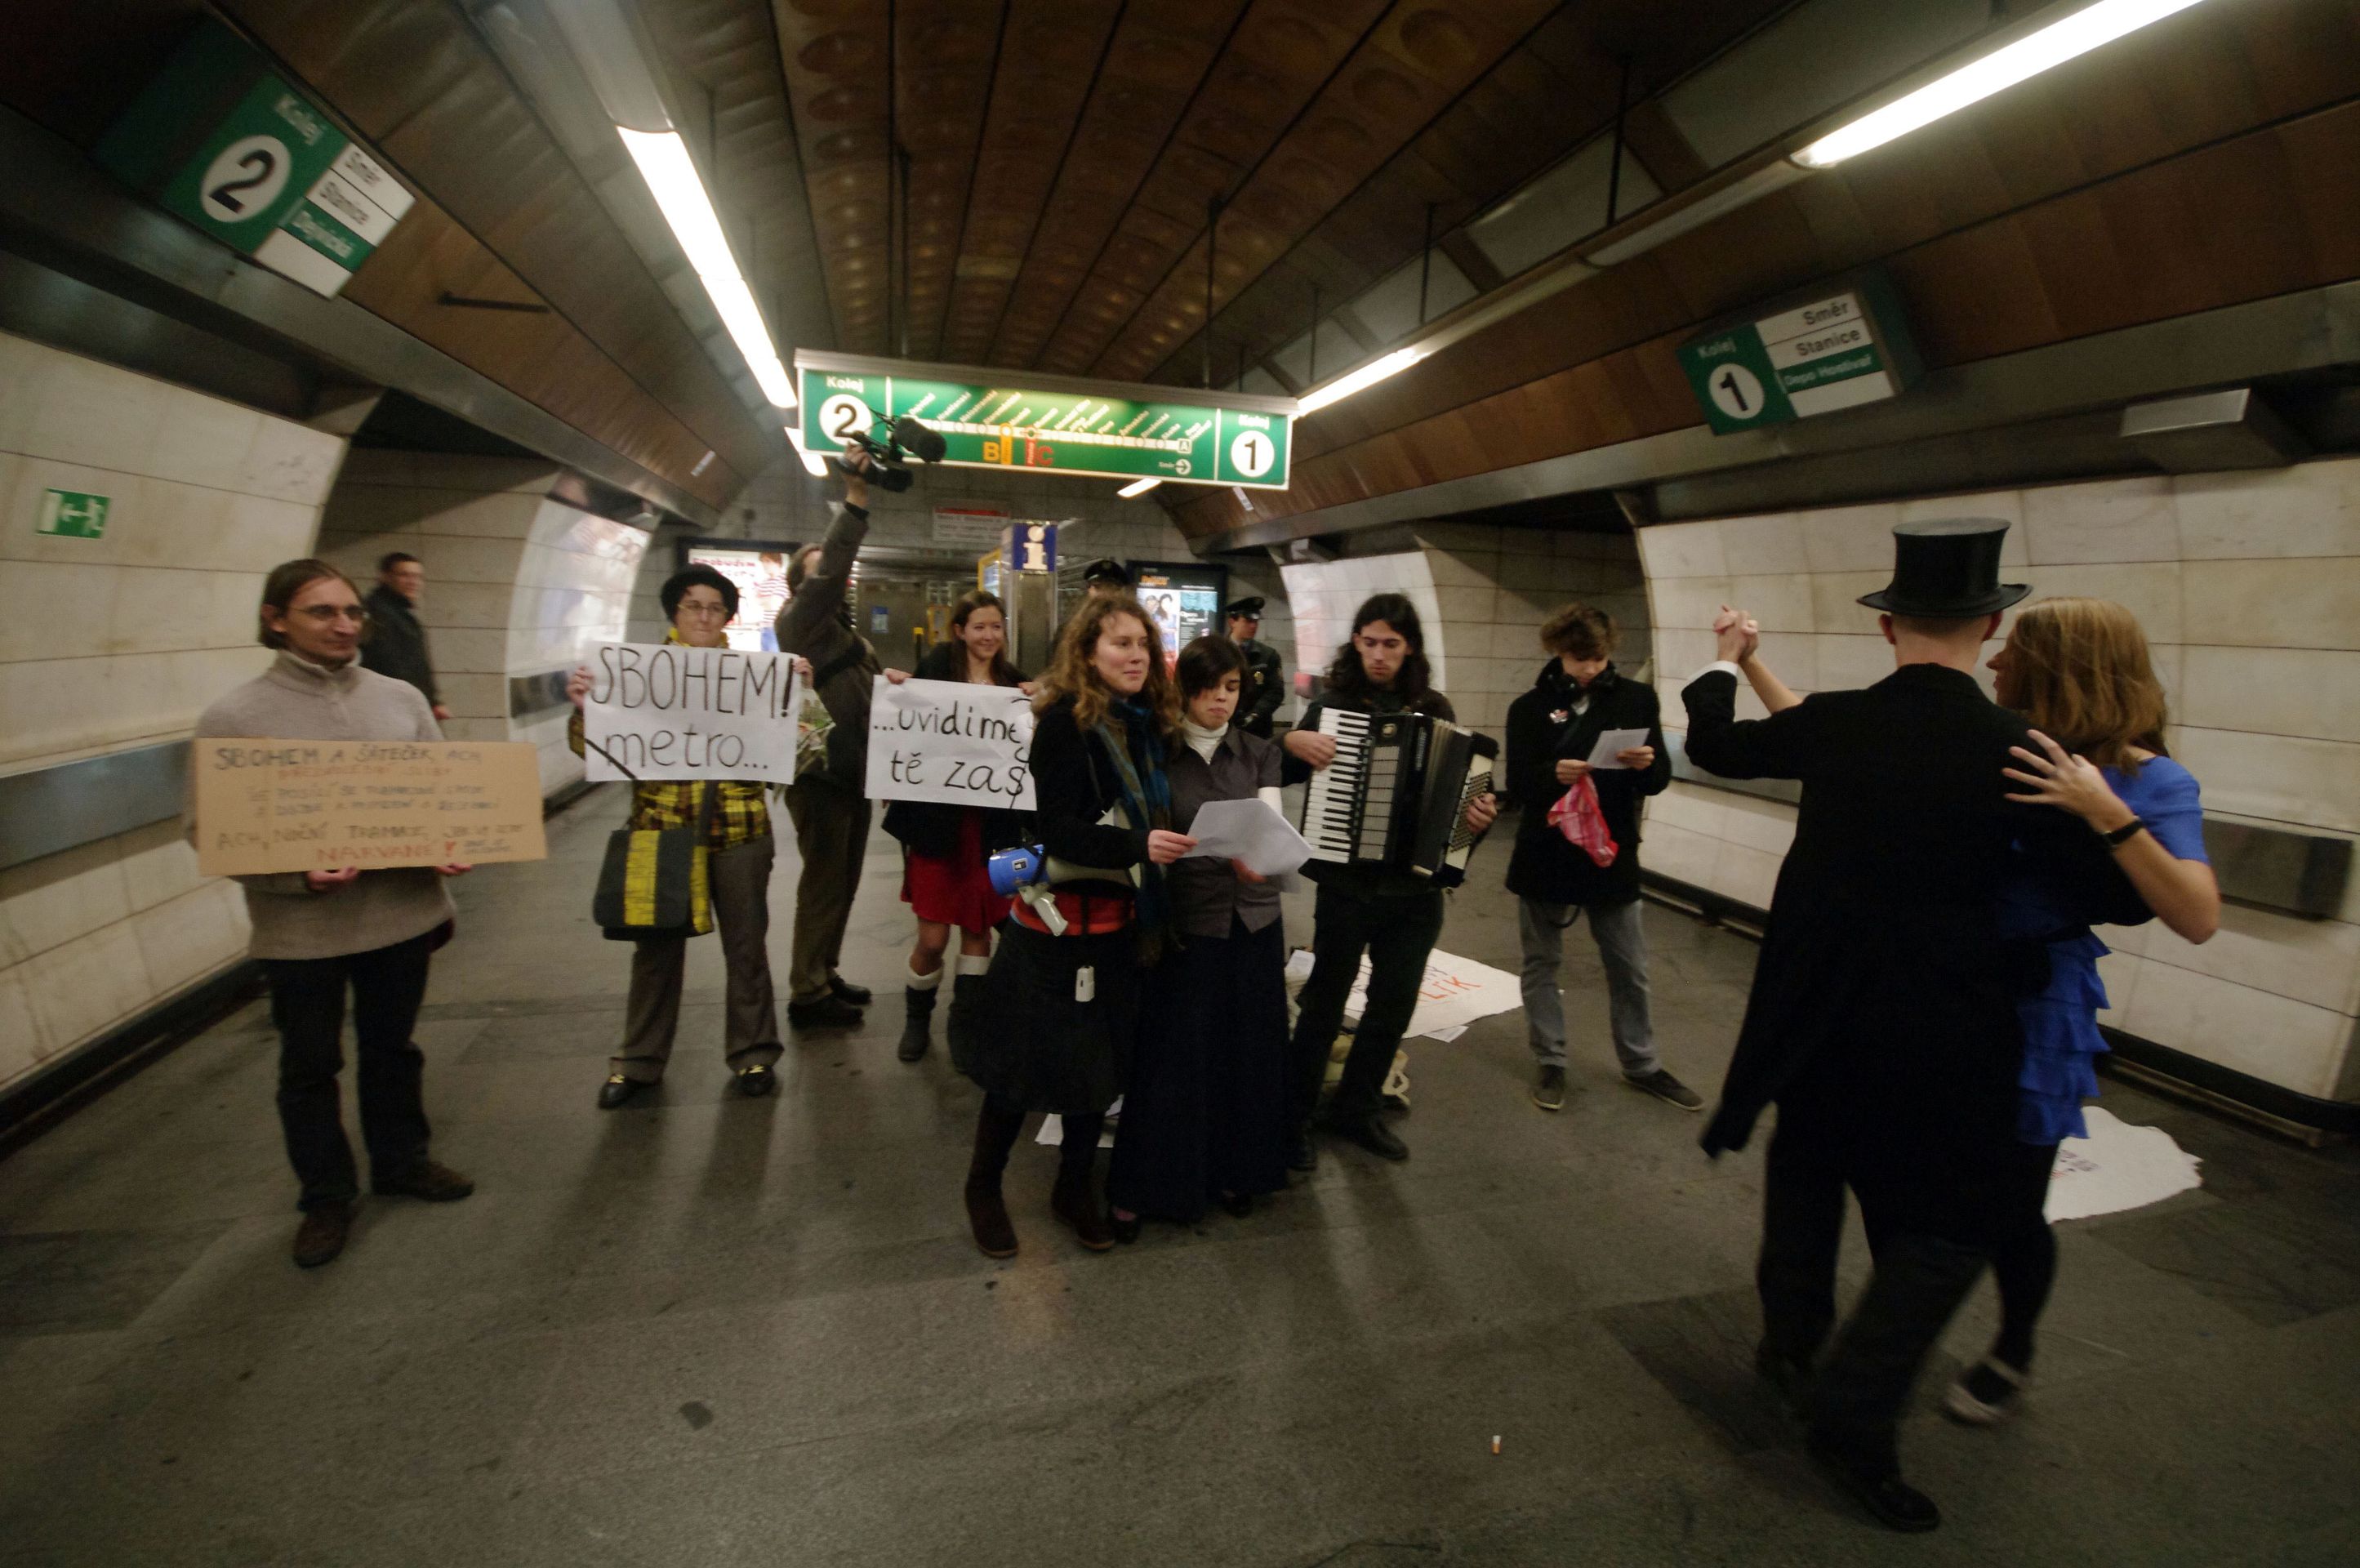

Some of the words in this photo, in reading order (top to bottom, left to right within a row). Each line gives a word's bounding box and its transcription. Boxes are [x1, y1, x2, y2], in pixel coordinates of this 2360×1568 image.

[209, 149, 276, 214] 2
[1803, 300, 1849, 326] Směr
[1797, 327, 1861, 357] Stanice
[826, 375, 865, 394] Kolej
[1719, 371, 1749, 412] 1
[834, 403, 857, 439] 2
[983, 441, 1000, 461] B
[1037, 445, 1053, 466] C
[1245, 439, 1256, 470] 1
[590, 646, 795, 719] SBOHEM!
[215, 746, 320, 770] SBOHEM
[605, 722, 768, 769] metro...
[890, 750, 924, 785] tě
